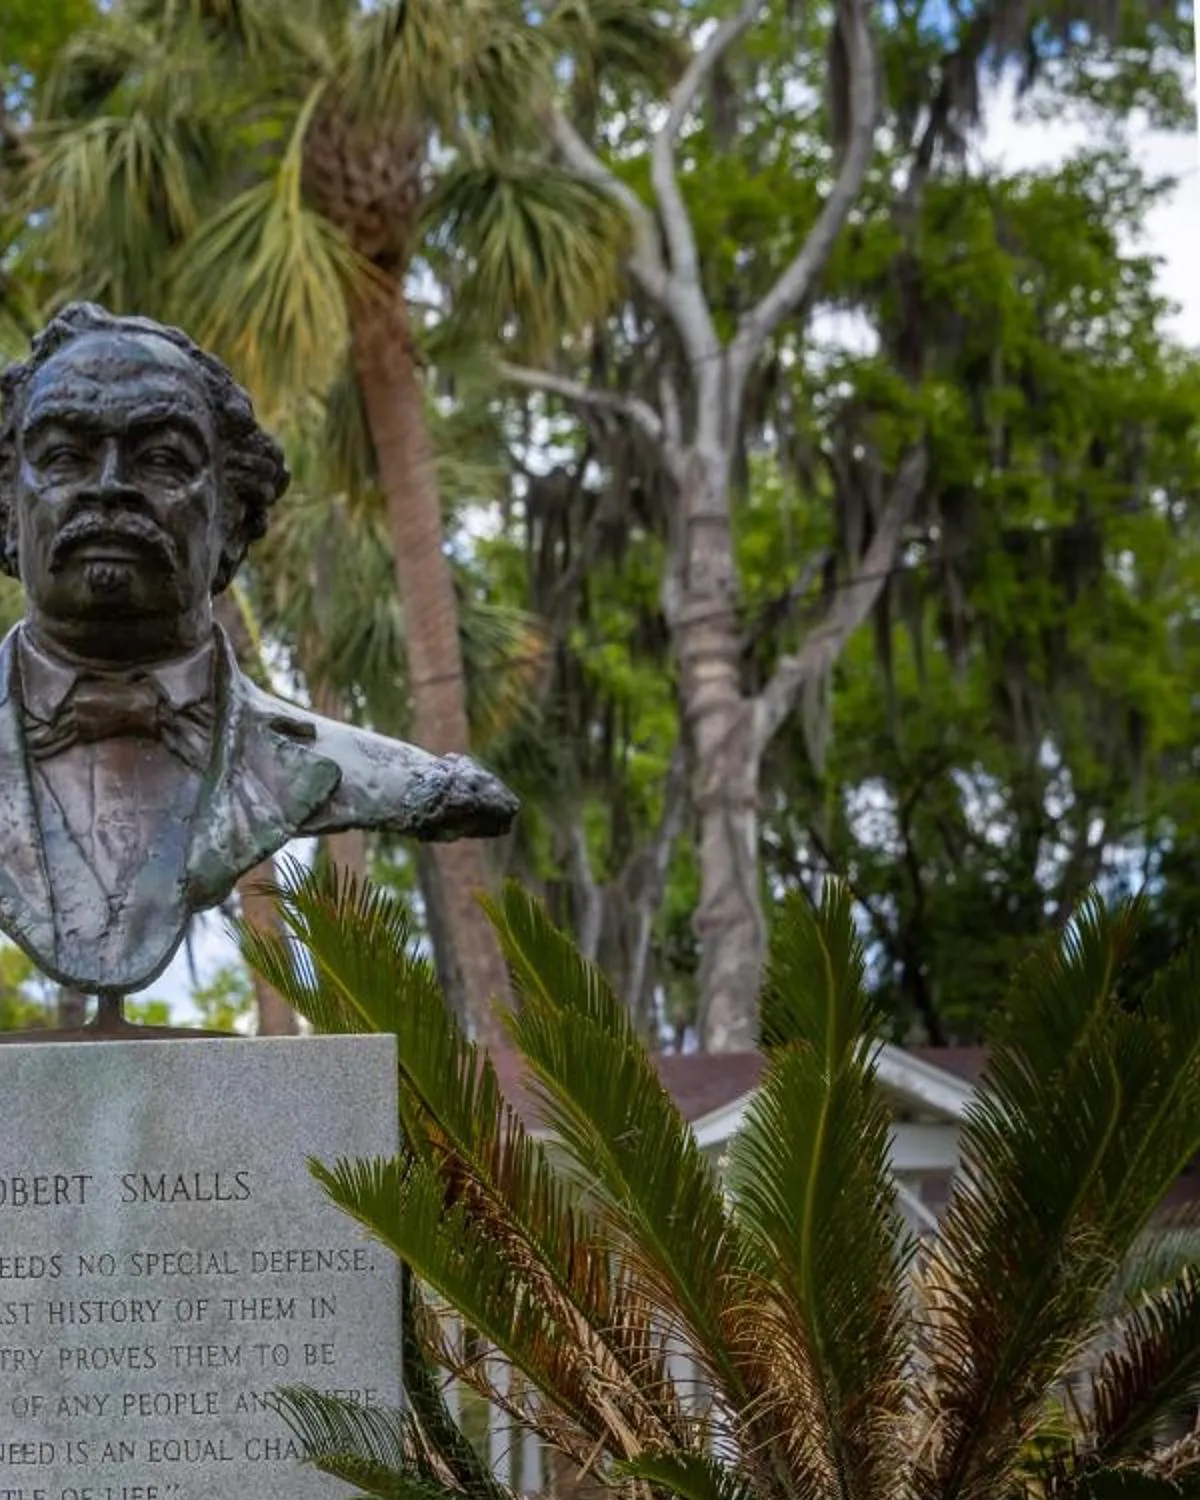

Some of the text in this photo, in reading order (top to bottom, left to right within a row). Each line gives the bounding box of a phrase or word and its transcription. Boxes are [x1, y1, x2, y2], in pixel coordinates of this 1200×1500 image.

[120, 1170, 252, 1204] SMALLS
[78, 1252, 117, 1277] NO
[130, 1251, 239, 1277] SPECIAL
[48, 1299, 163, 1325] HISTORY
[175, 1299, 209, 1322] OF
[223, 1297, 296, 1321] THEM
[311, 1295, 338, 1319] IN
[59, 1346, 158, 1371] PROVES
[170, 1345, 242, 1369] THEM
[252, 1342, 290, 1367] TO
[304, 1342, 337, 1366] BE
[11, 1395, 46, 1419] OF
[56, 1392, 111, 1417] ANY
[122, 1391, 220, 1417] PEOPLE
[66, 1440, 90, 1465] IS
[100, 1440, 139, 1463] AN
[147, 1438, 235, 1464] EQUAL
